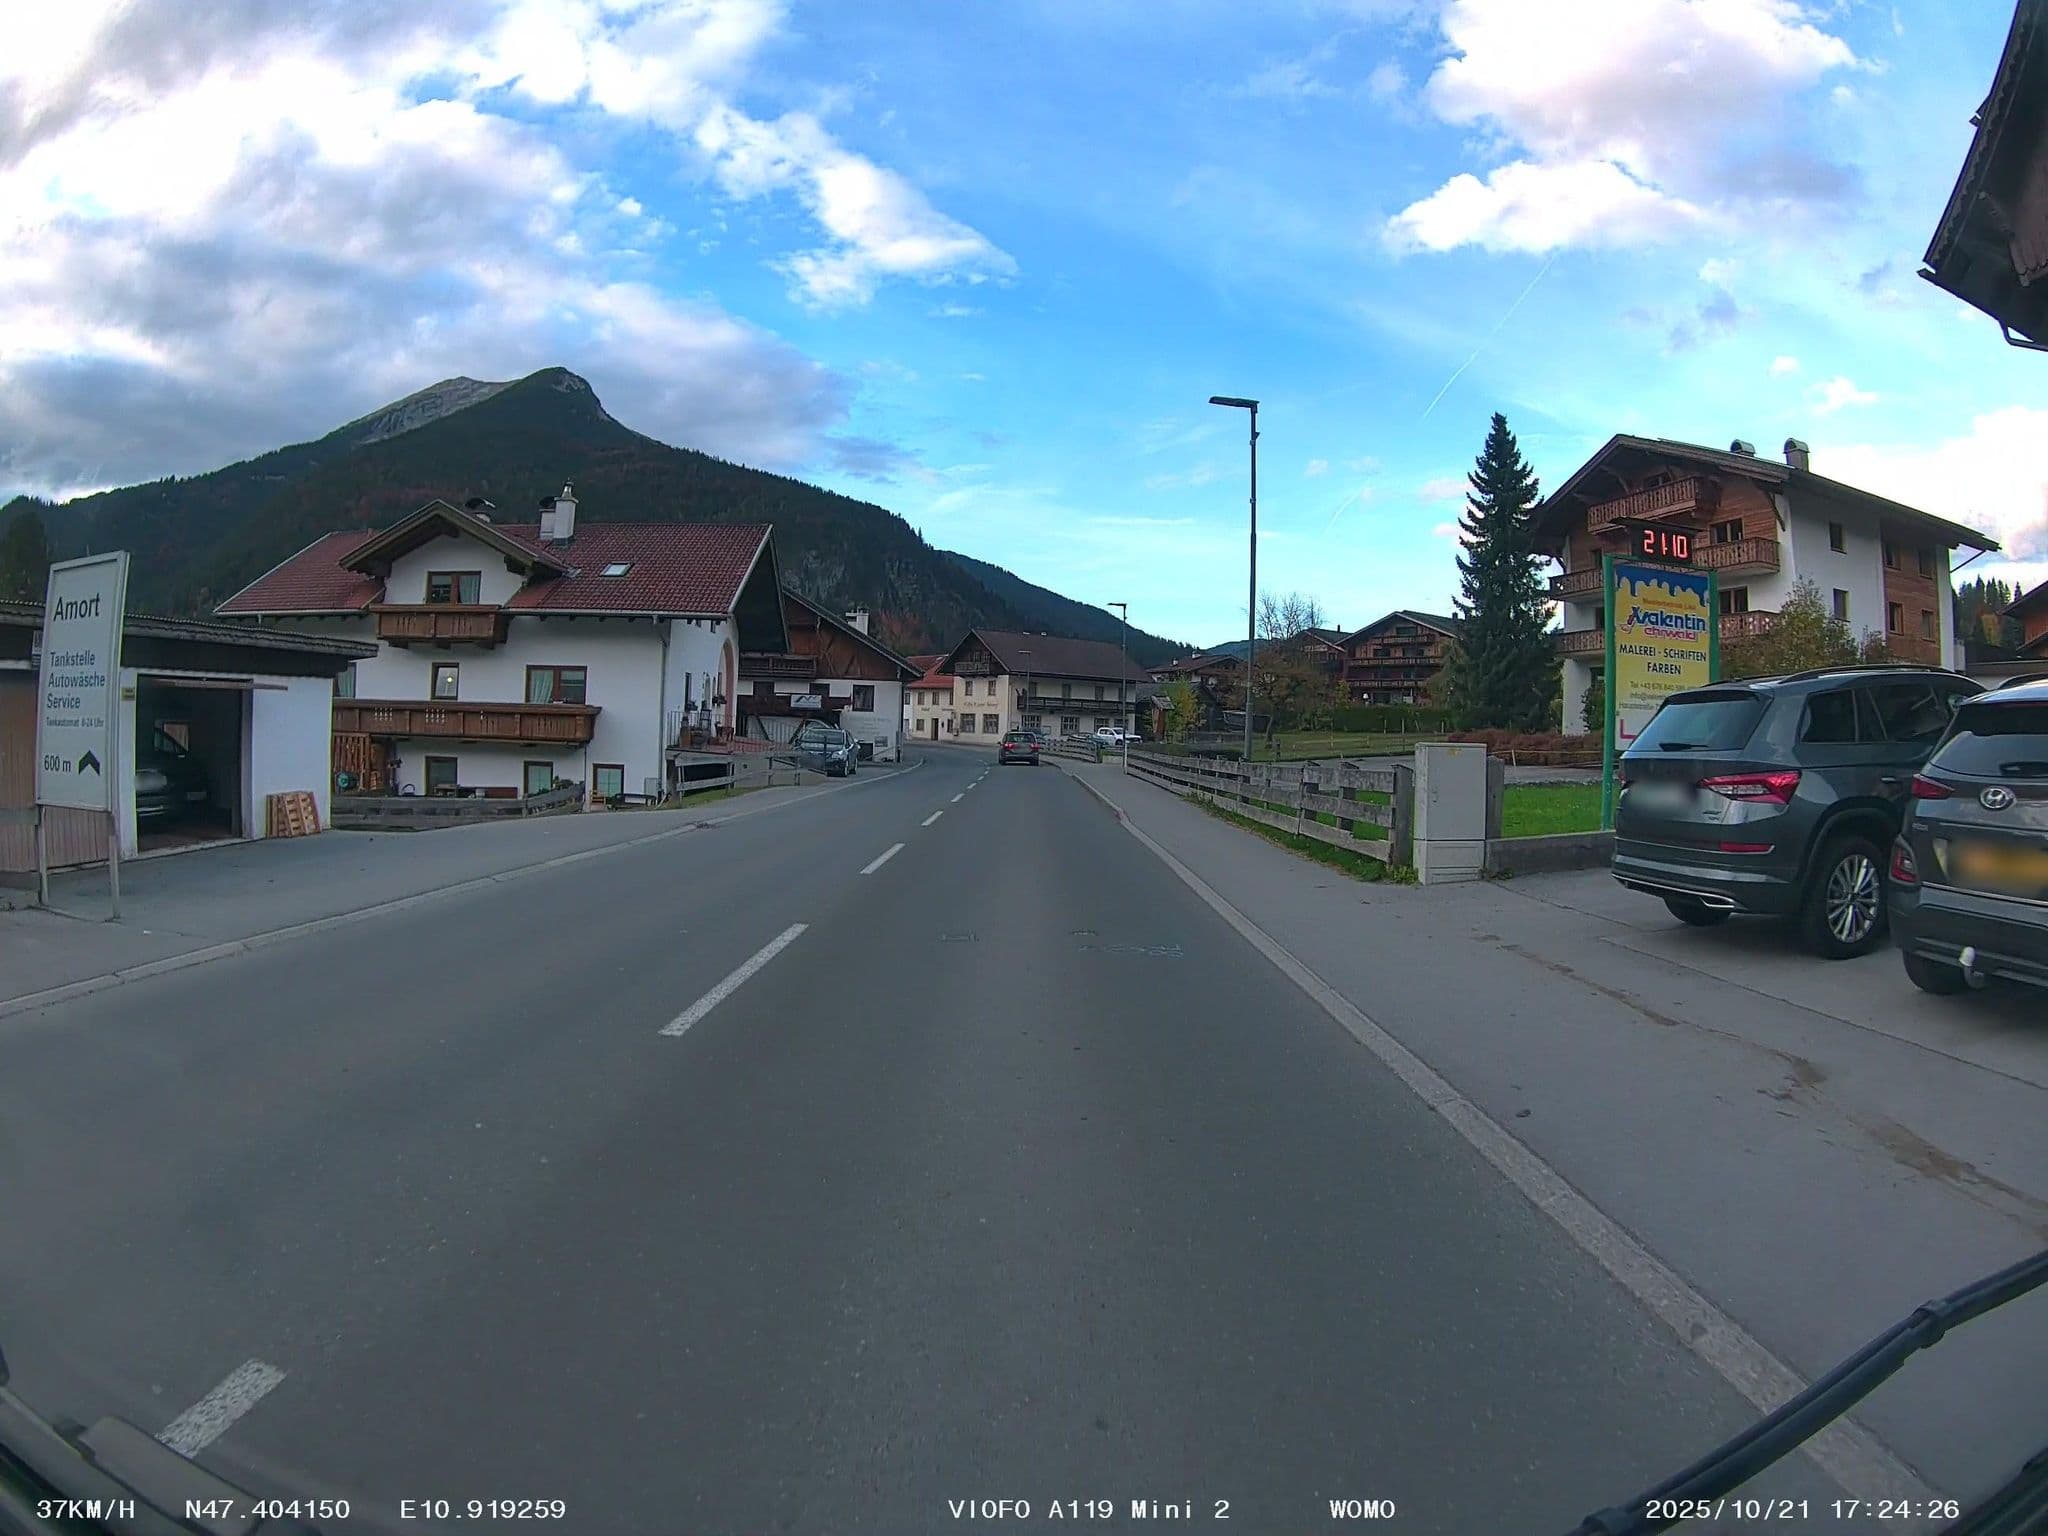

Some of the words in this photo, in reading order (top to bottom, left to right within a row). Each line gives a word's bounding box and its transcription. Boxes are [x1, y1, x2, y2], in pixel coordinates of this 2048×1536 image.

[53, 592, 100, 621] Amort
[50, 650, 96, 668] Tankstelle
[1619, 643, 1656, 657] MALEREI
[1663, 647, 1707, 662] SCHRIFTEN
[1647, 661, 1682, 675] FARBEN
[48, 671, 106, 688] Autowäsche
[46, 692, 81, 709] Service
[44, 755, 60, 772] 600
[62, 760, 72, 772] m
